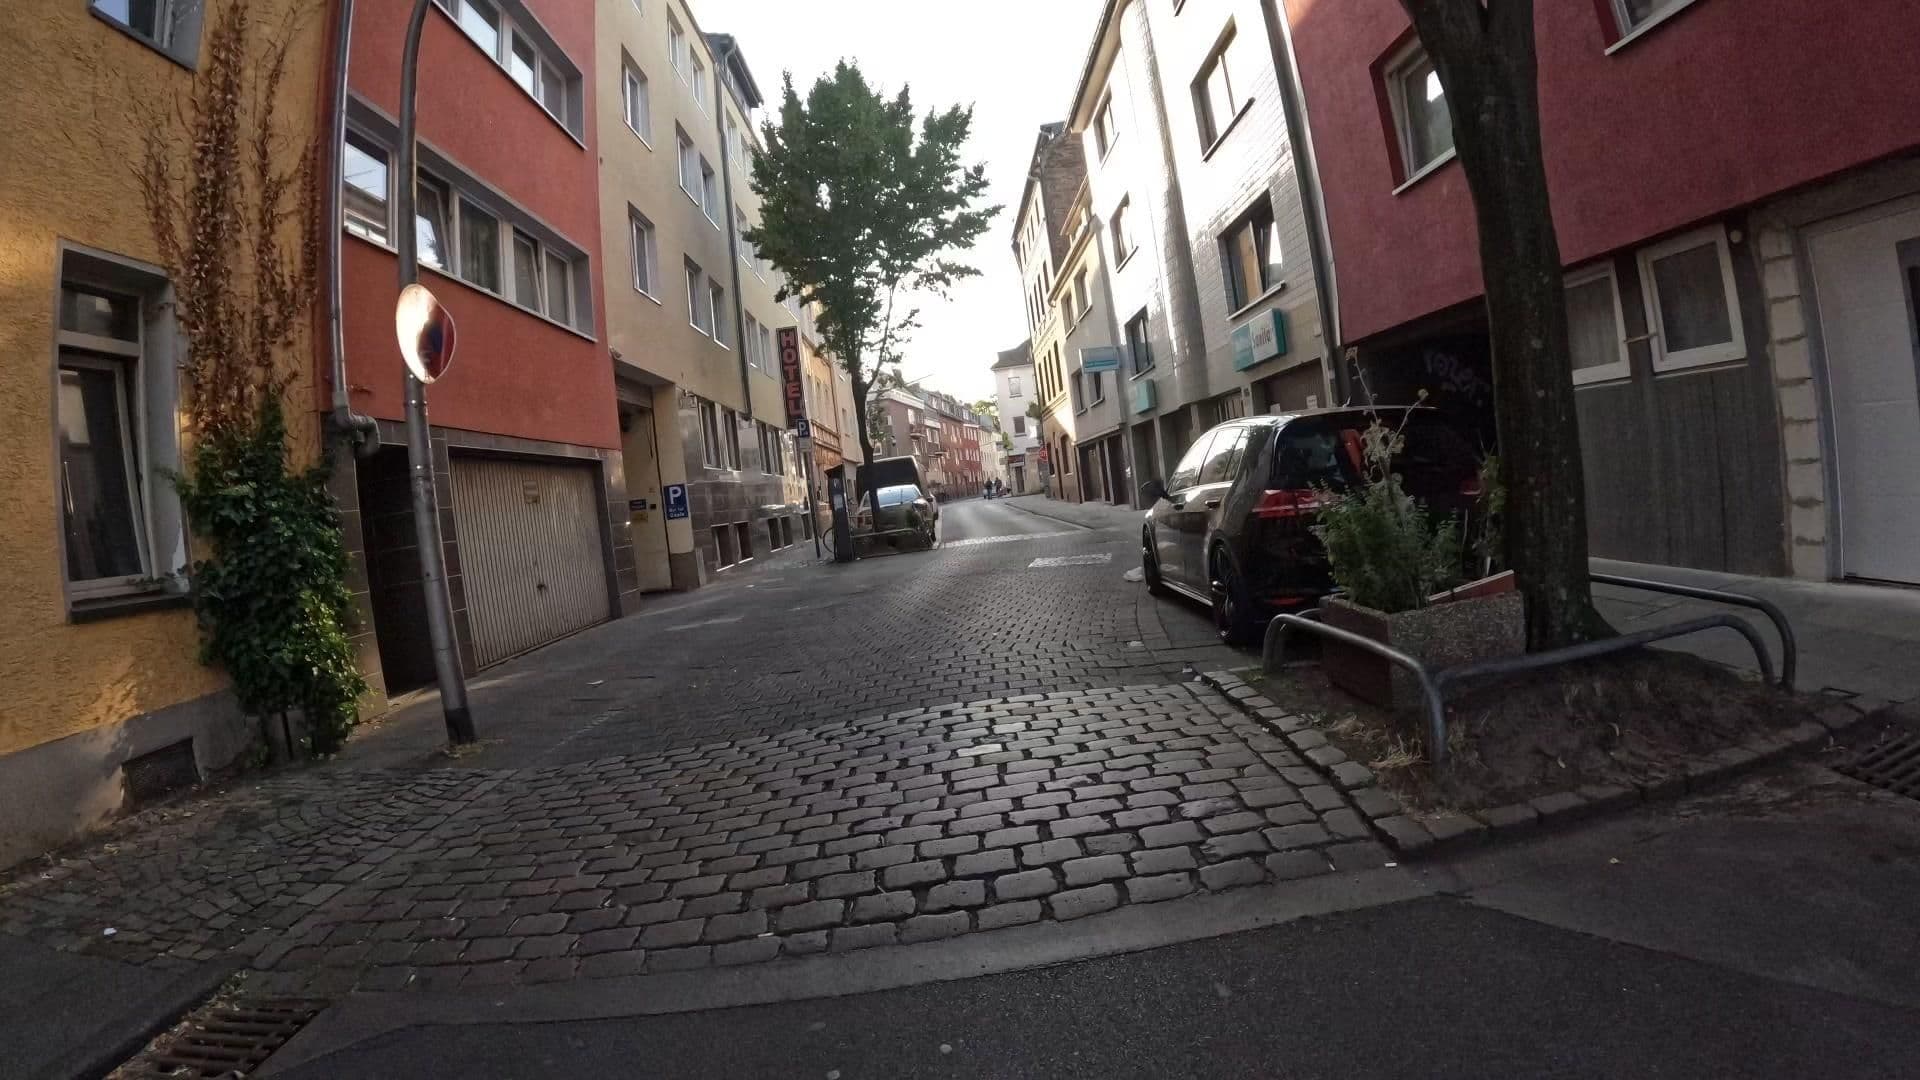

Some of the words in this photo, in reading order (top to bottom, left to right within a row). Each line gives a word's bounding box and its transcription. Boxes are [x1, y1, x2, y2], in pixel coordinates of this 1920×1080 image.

[780, 330, 802, 416] HOTEL
[798, 421, 807, 436] P
[669, 486, 681, 504] P
